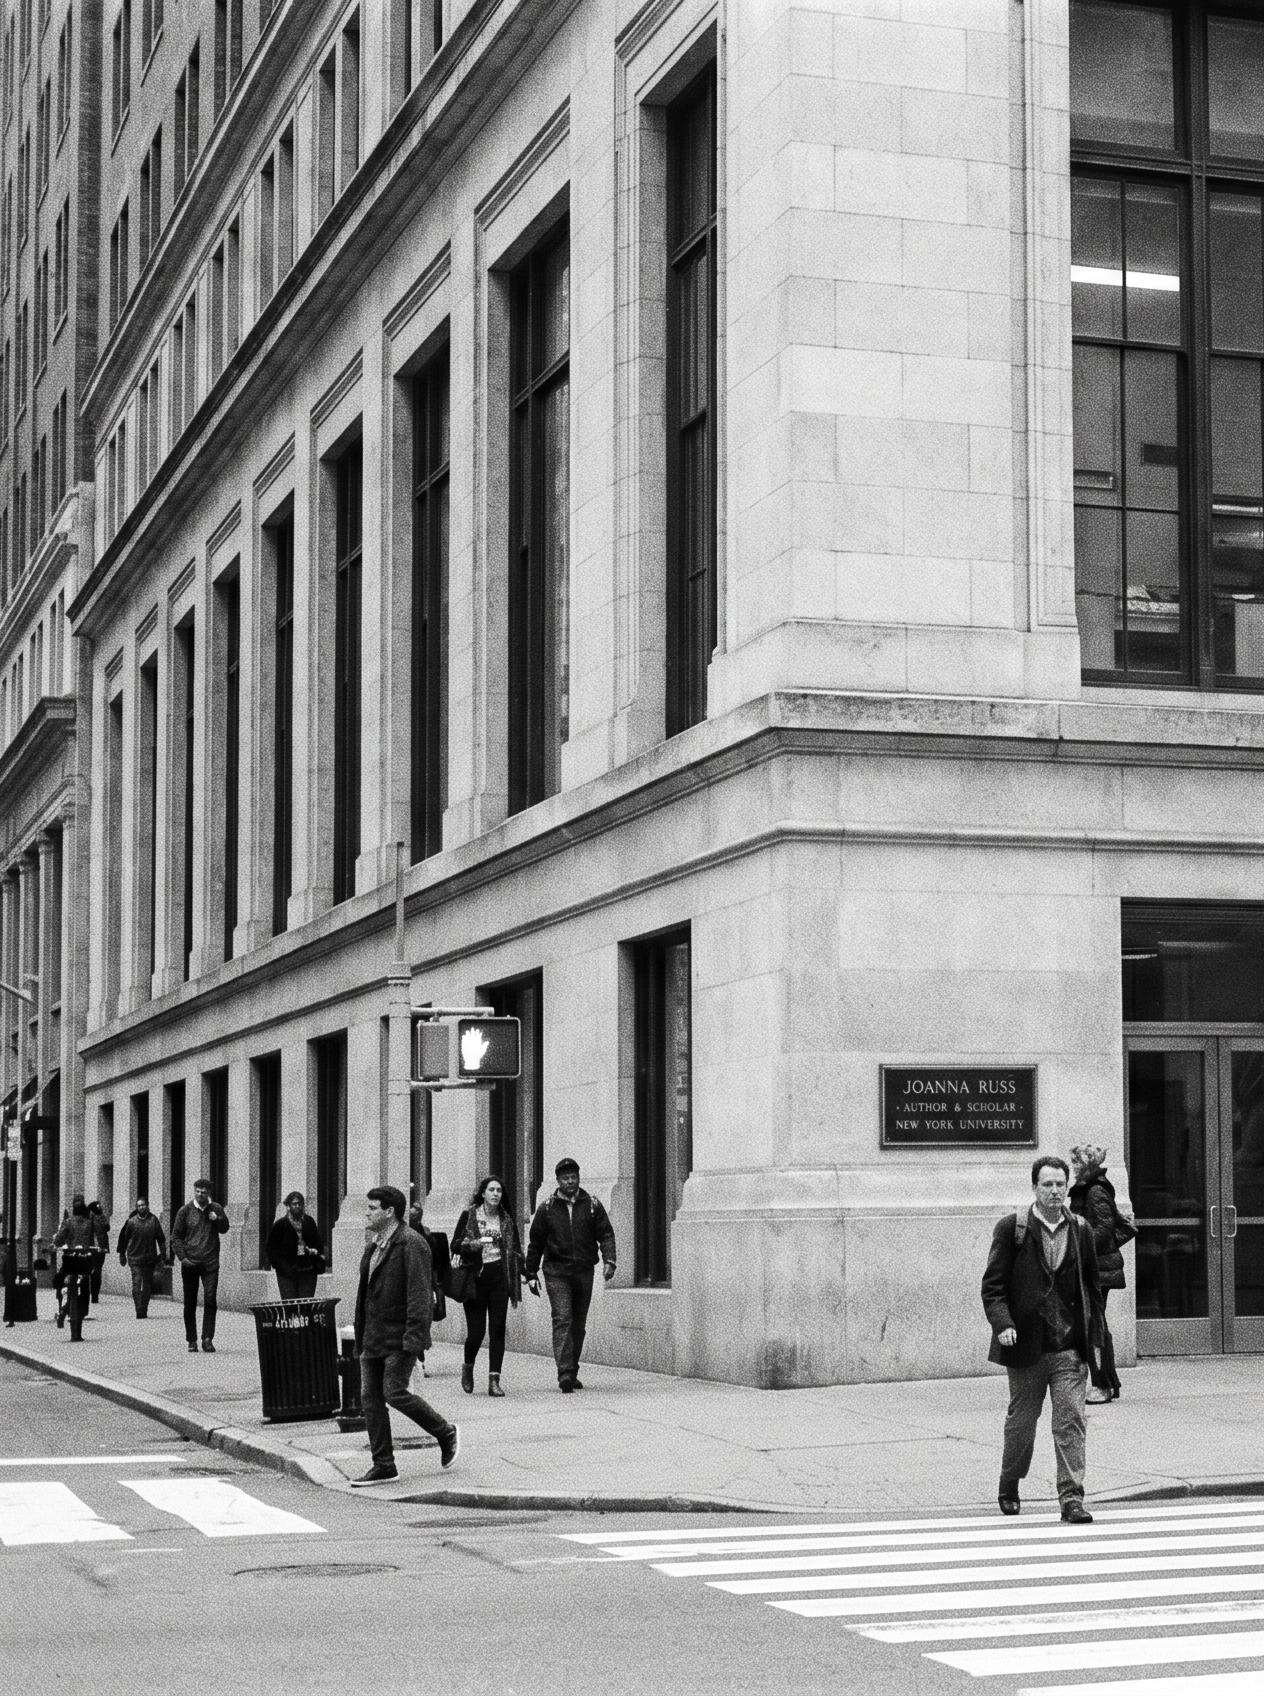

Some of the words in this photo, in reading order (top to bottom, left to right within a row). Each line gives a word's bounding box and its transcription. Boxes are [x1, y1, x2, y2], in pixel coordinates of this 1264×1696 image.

[902, 1080, 970, 1095] JOANNA
[978, 1080, 1016, 1095] RUSS
[903, 1102, 948, 1112] AUTHOR
[954, 1102, 962, 1112] &
[967, 1102, 1017, 1112] SCHOLAR
[895, 1119, 919, 1130] NEW
[925, 1119, 954, 1130] YORK
[959, 1119, 1024, 1130] UNIVERSITY
